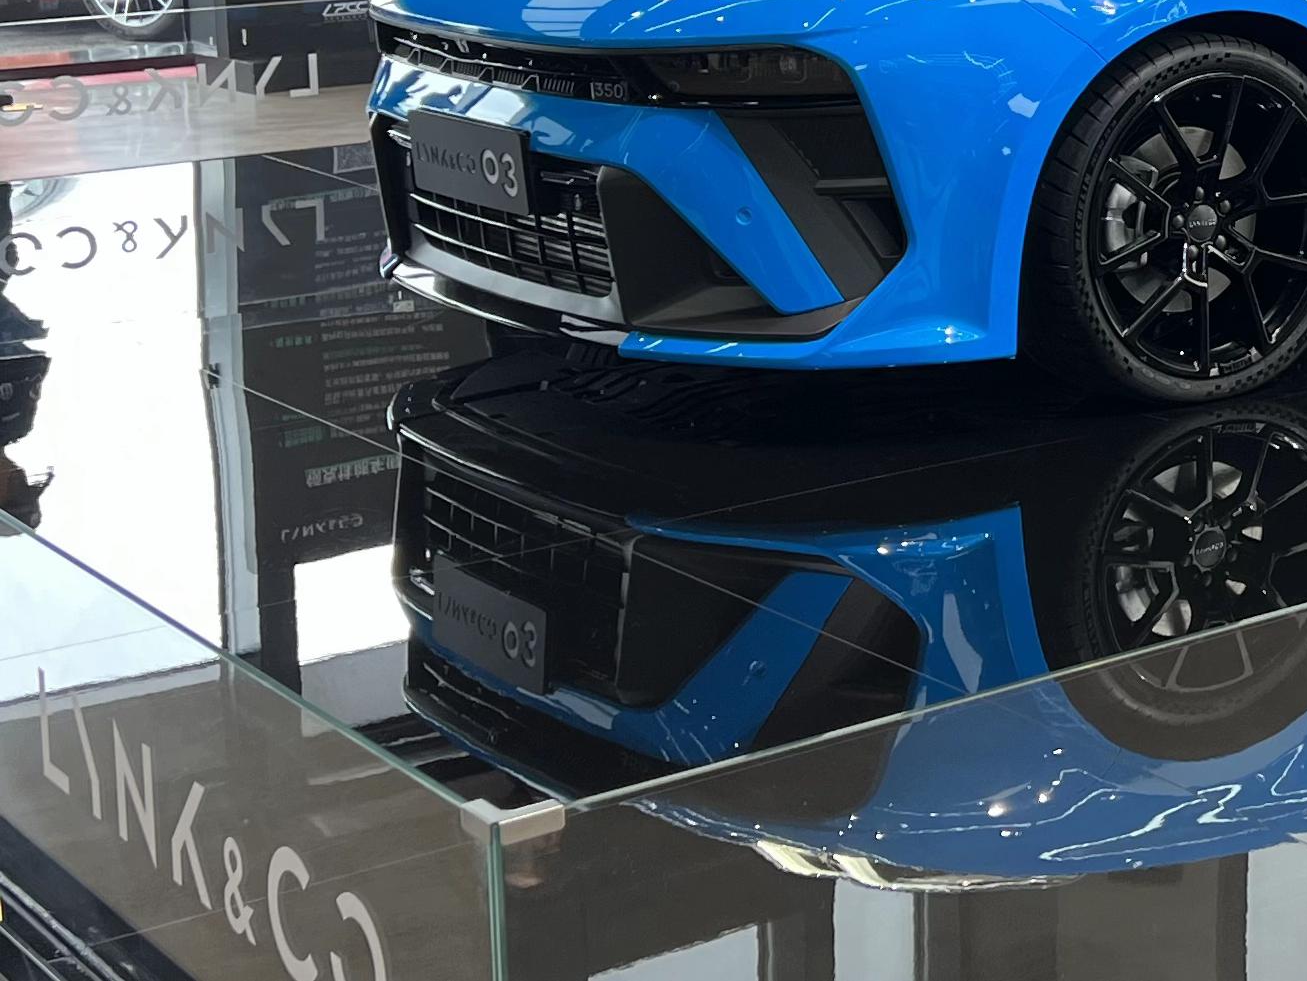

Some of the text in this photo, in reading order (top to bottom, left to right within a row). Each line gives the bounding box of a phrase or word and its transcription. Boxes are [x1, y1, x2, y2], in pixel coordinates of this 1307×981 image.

[594, 82, 624, 99] 350
[481, 148, 519, 198] 03
[37, 666, 388, 981] LYNK&CO
